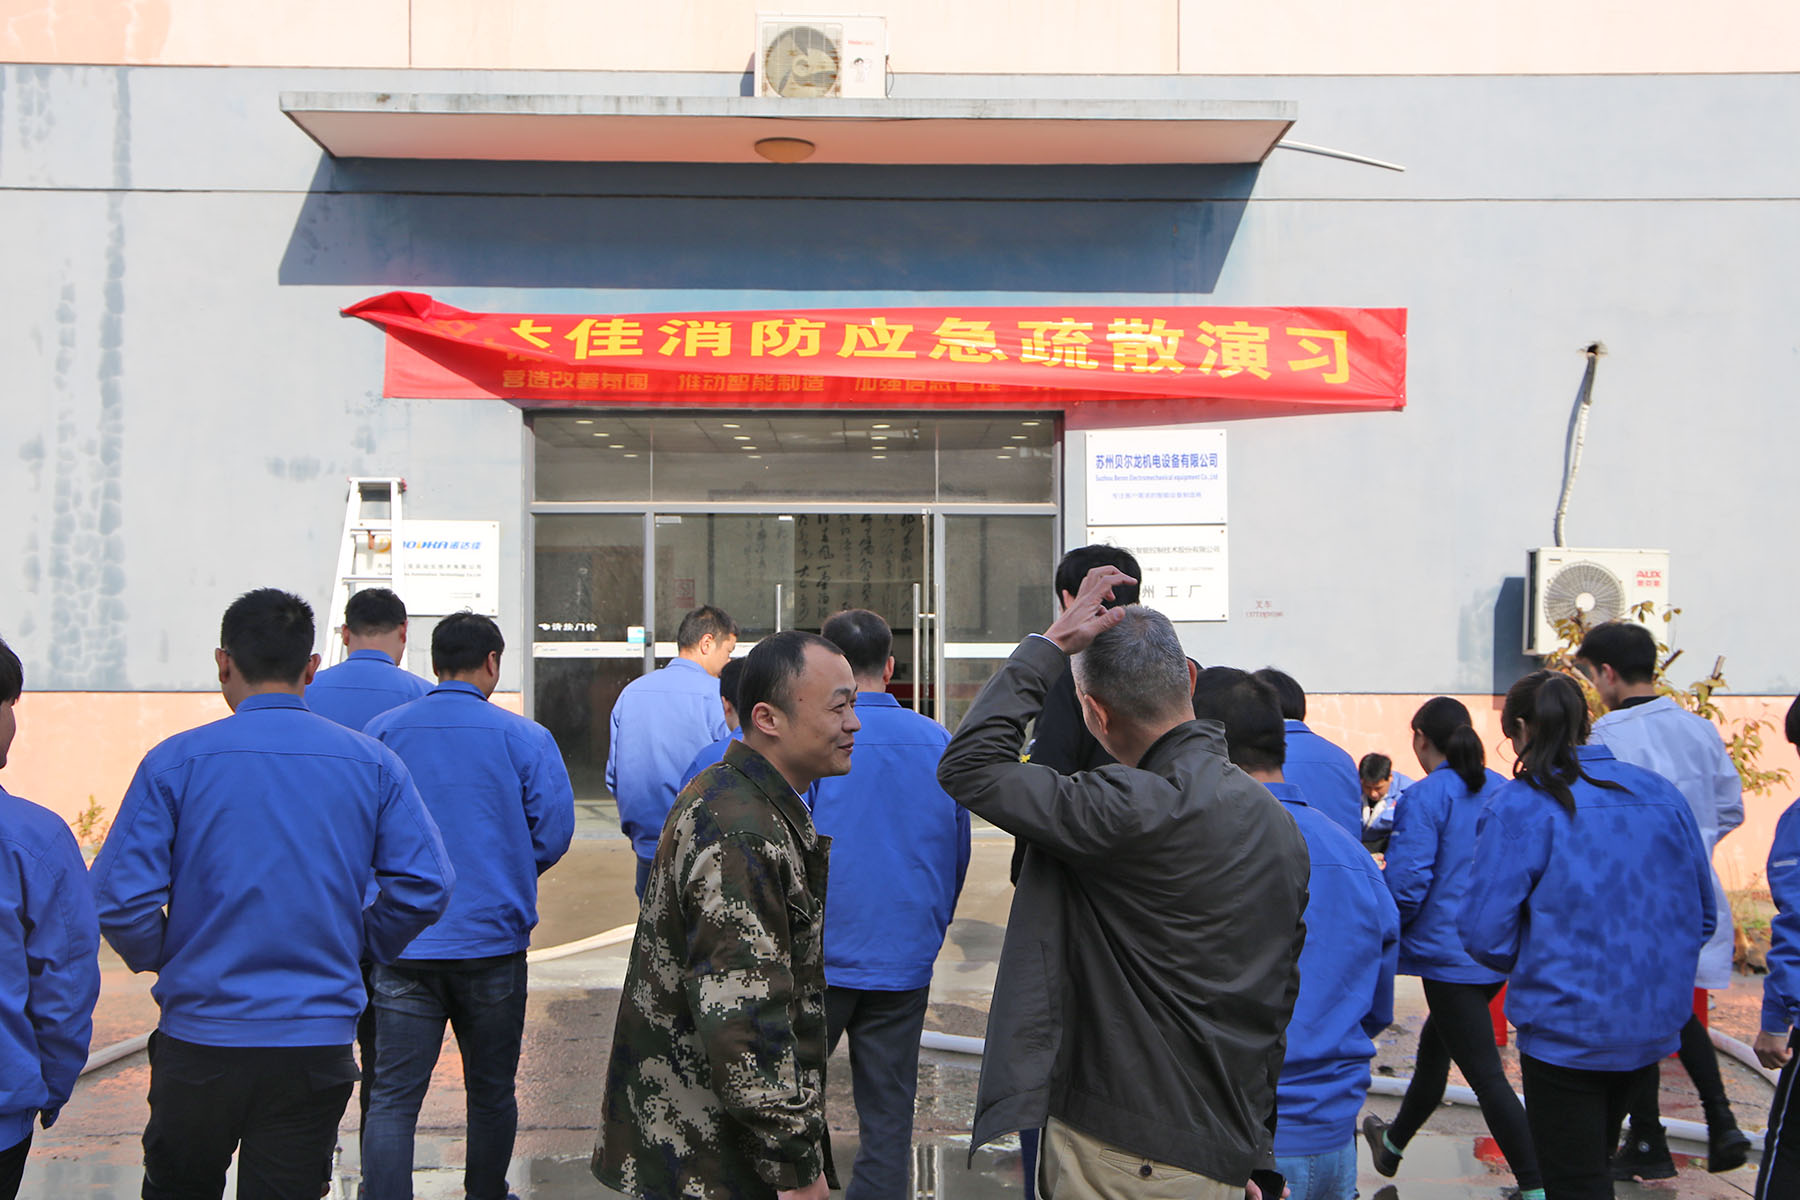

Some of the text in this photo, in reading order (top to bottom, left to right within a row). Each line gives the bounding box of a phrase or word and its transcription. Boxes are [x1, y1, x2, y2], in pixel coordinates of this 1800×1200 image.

[502, 370, 649, 392] 营造改善氛围
[678, 373, 826, 393] 推动智能制造
[1095, 453, 1218, 470] 苏州贝尔龙机电设备有限公司
[1636, 570, 1661, 578] AUX
[1142, 584, 1202, 599] 州工厂
